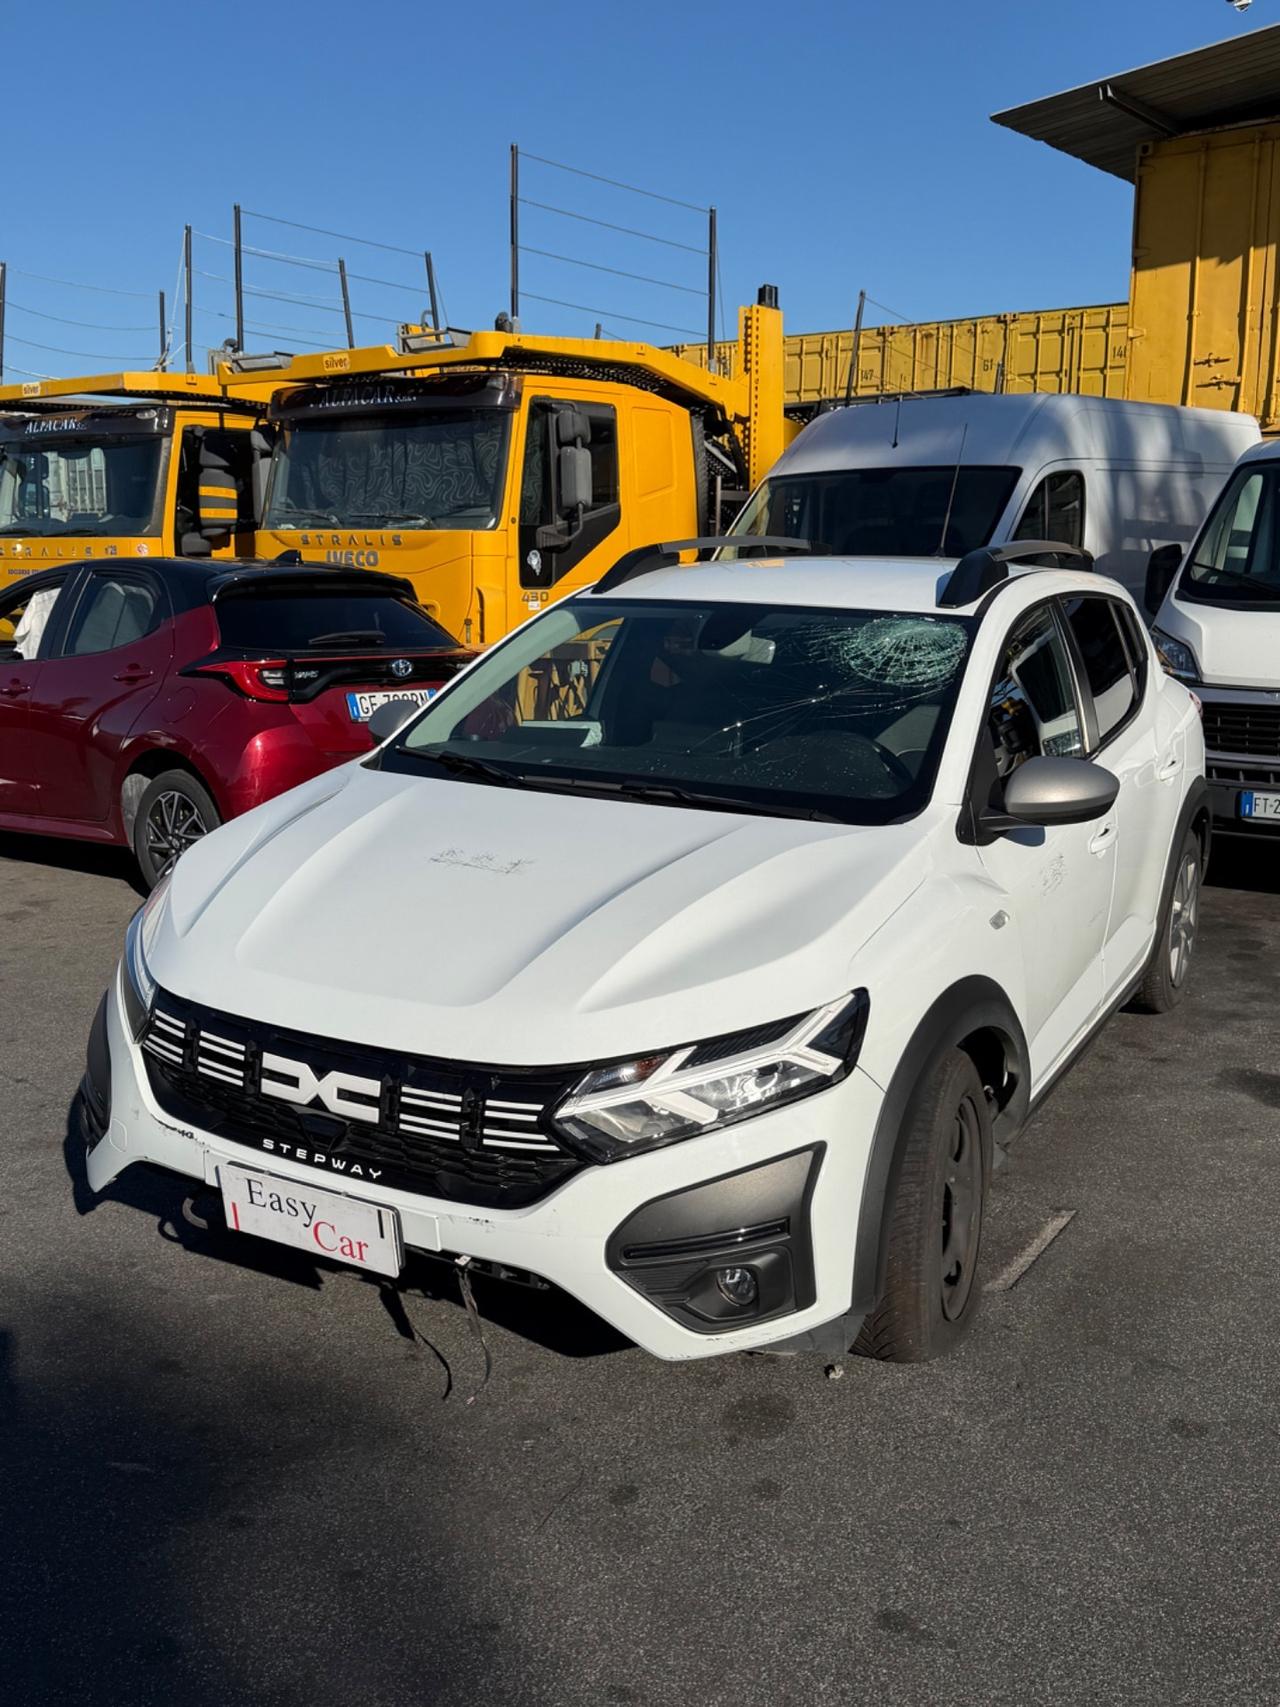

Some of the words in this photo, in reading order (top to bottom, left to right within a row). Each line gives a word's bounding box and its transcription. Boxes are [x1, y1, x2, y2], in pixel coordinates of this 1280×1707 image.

[325, 356, 348, 369] silver
[300, 534, 402, 546] STRALIS
[326, 550, 379, 567] IVECO
[262, 1138, 382, 1179] STEPWAY
[246, 1177, 317, 1228] Easy
[312, 1220, 369, 1263] Car
